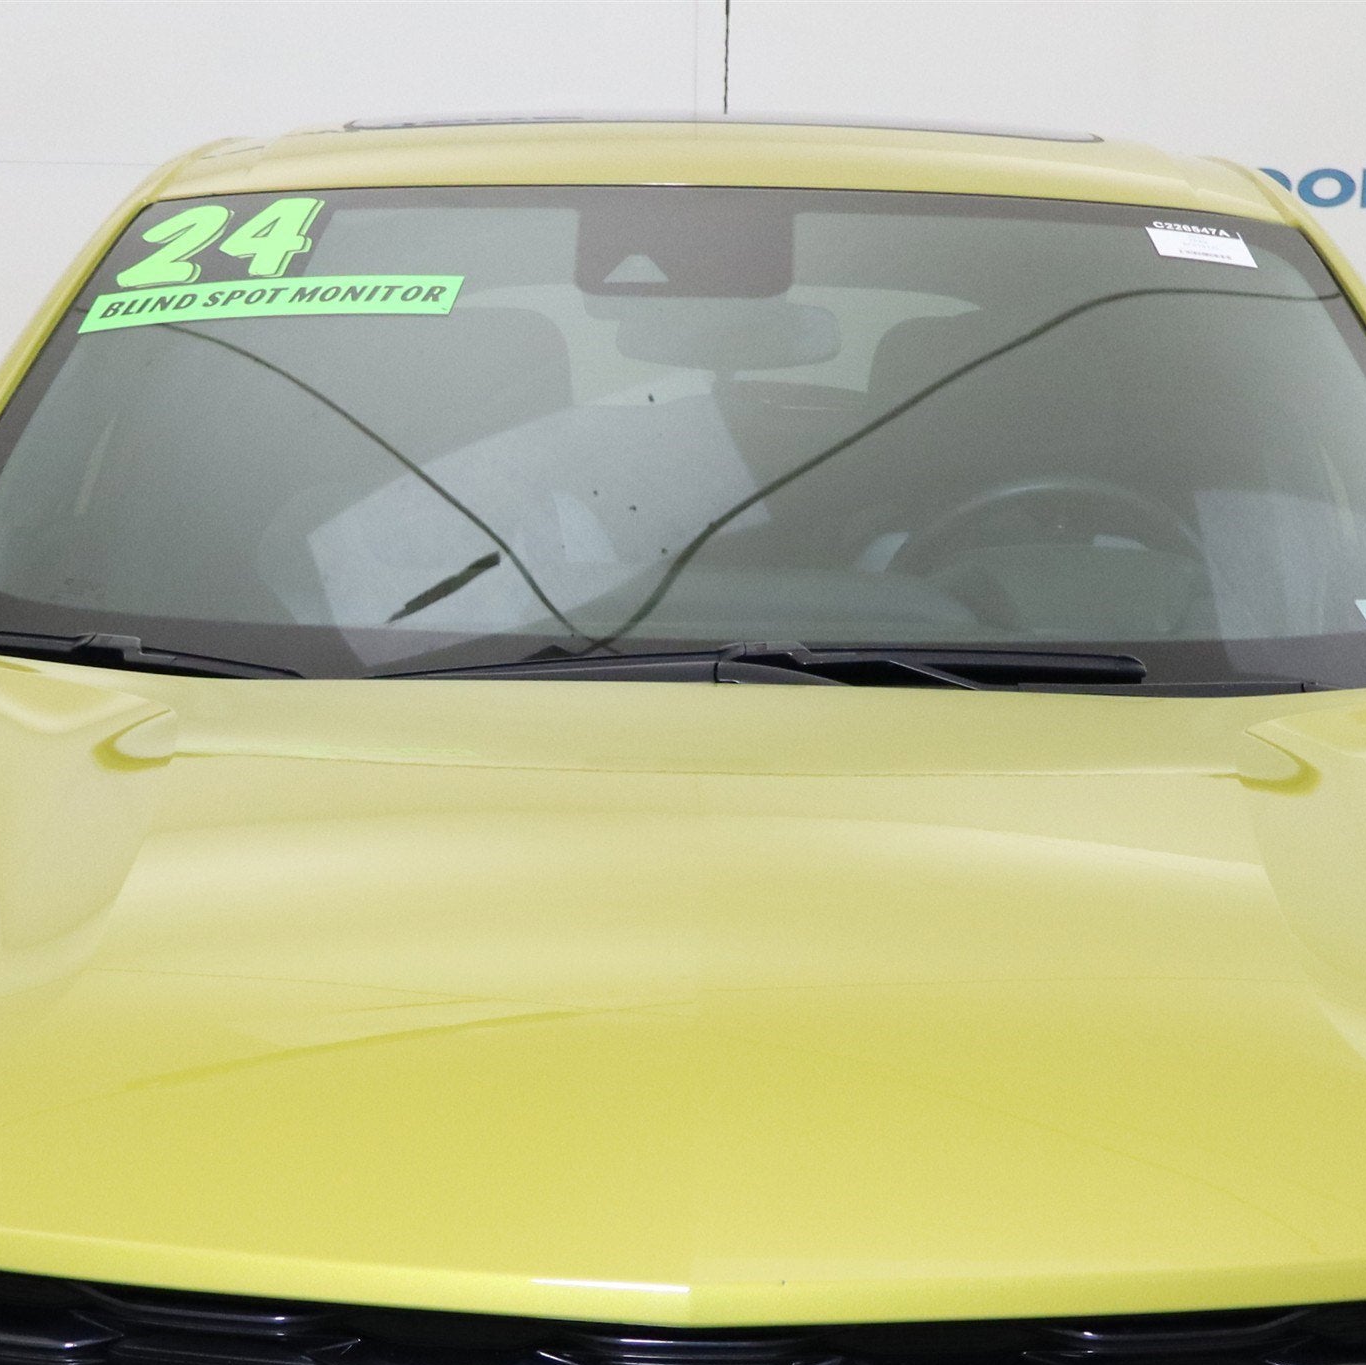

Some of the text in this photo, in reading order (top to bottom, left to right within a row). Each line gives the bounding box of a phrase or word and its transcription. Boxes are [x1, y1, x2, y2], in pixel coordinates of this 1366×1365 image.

[116, 197, 325, 288] 24
[99, 284, 448, 320] BLIND SPOT MONITOR
